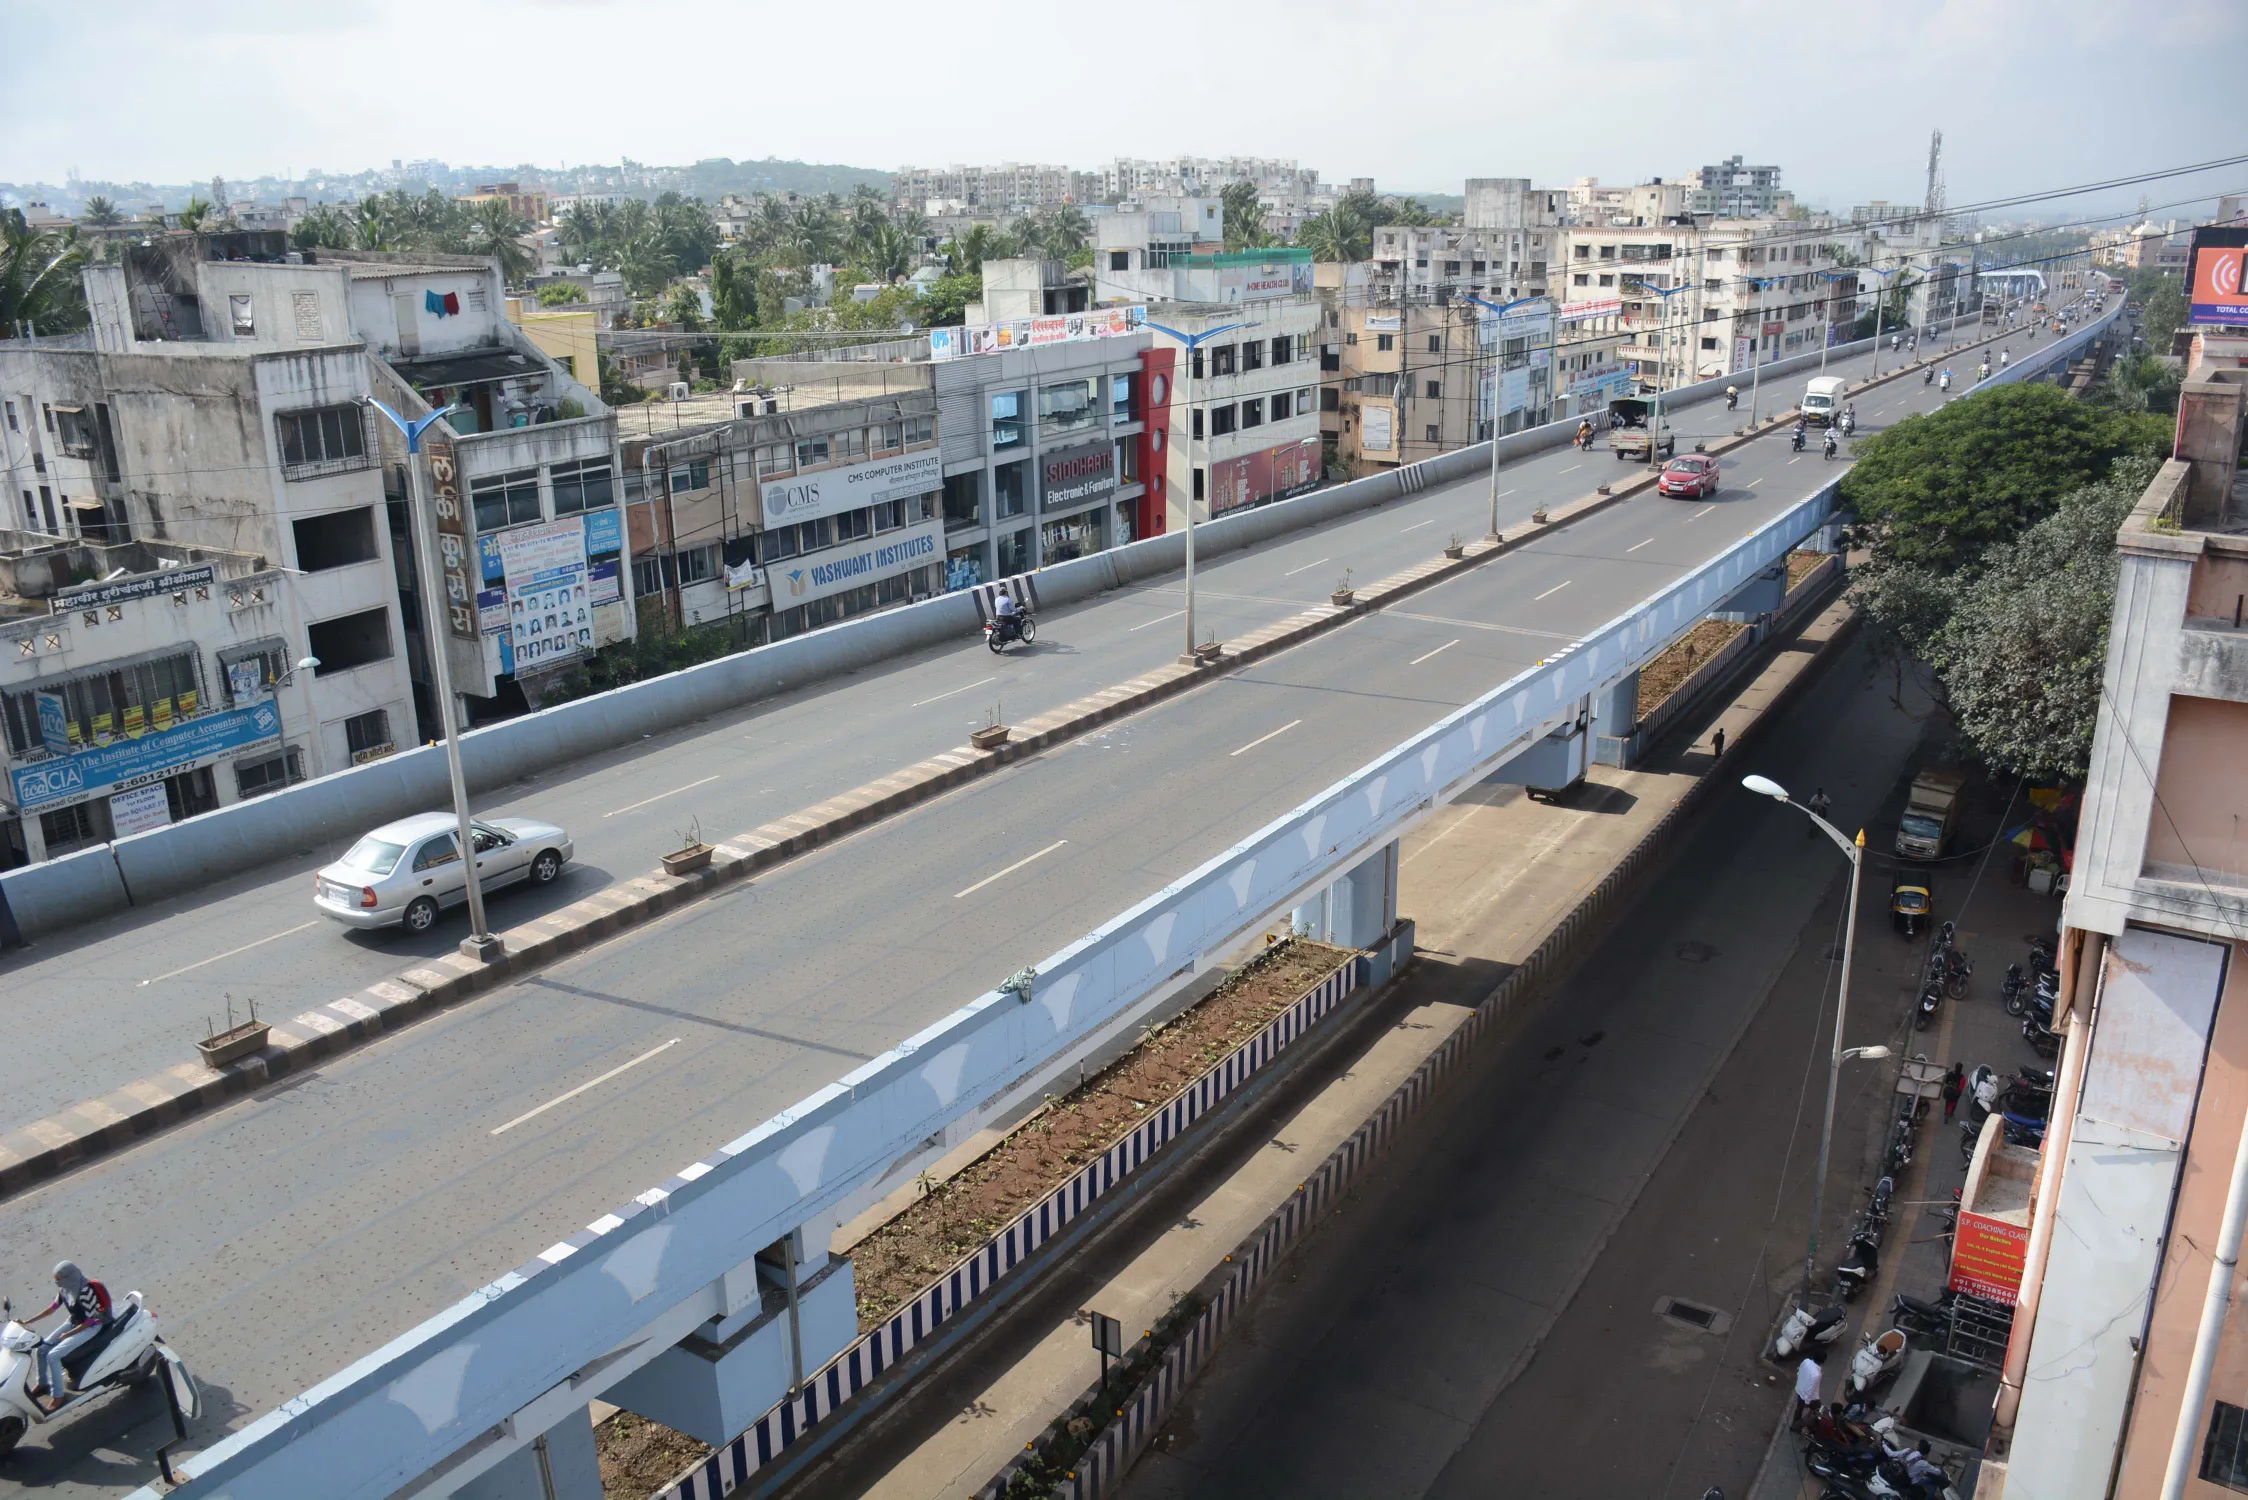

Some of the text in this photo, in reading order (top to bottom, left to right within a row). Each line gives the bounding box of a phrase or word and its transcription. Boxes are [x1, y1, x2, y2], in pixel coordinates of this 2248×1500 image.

[1261, 281, 1278, 290] HEALTH
[1278, 278, 1290, 287] CLUB
[932, 329, 950, 350] 0%
[847, 456, 939, 484] CMS COMPUTER INSTITUTE
[1048, 450, 1115, 483] SIDDHARTH
[787, 482, 820, 508] CMS
[1047, 485, 1084, 505] Electronic
[1089, 477, 1114, 494] Furniture
[811, 534, 934, 587] YASHWANT INSTITUTES
[258, 711, 274, 729] JOB
[81, 755, 99, 768] The
[101, 744, 140, 762] Institute
[141, 739, 151, 752] of
[152, 729, 196, 752] Computer
[197, 713, 249, 736] Accountants
[47, 766, 81, 791] CIA
[24, 792, 90, 816] Dhankawadi Center
[111, 783, 165, 804] OFFICE SPACE
[130, 800, 157, 815] SQUARE
[117, 820, 127, 828] For
[128, 814, 143, 826] Rent
[1973, 1220, 2007, 1237] COACHING
[1979, 1232, 2012, 1246] Our Batches
[1967, 1254, 1983, 1263] English
[1954, 1278, 1969, 1286] +91
[1957, 1285, 1973, 1295] 020
